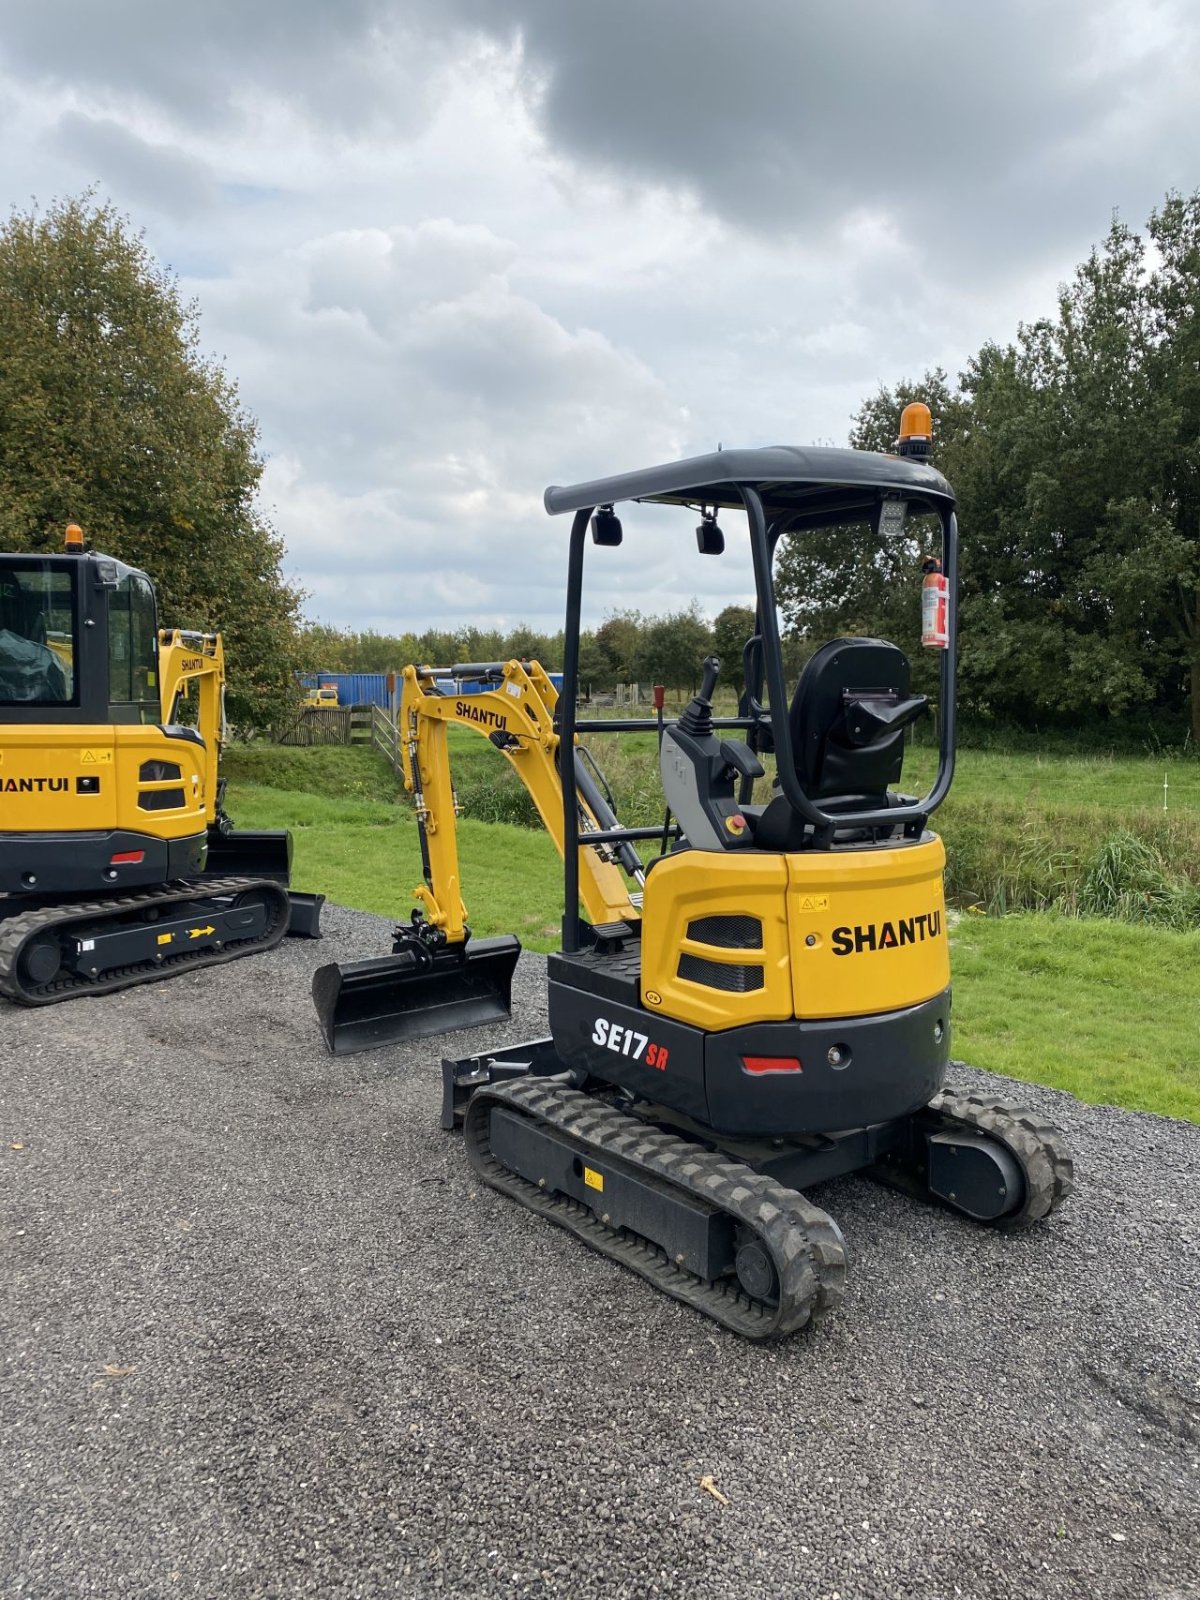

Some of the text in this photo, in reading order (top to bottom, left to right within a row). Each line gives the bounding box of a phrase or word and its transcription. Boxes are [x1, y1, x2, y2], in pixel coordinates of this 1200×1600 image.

[181, 658, 203, 671] SHANTUI
[456, 701, 507, 731] SHANTUI
[0, 777, 69, 792] ANTUI
[831, 909, 941, 956] SHANTUI
